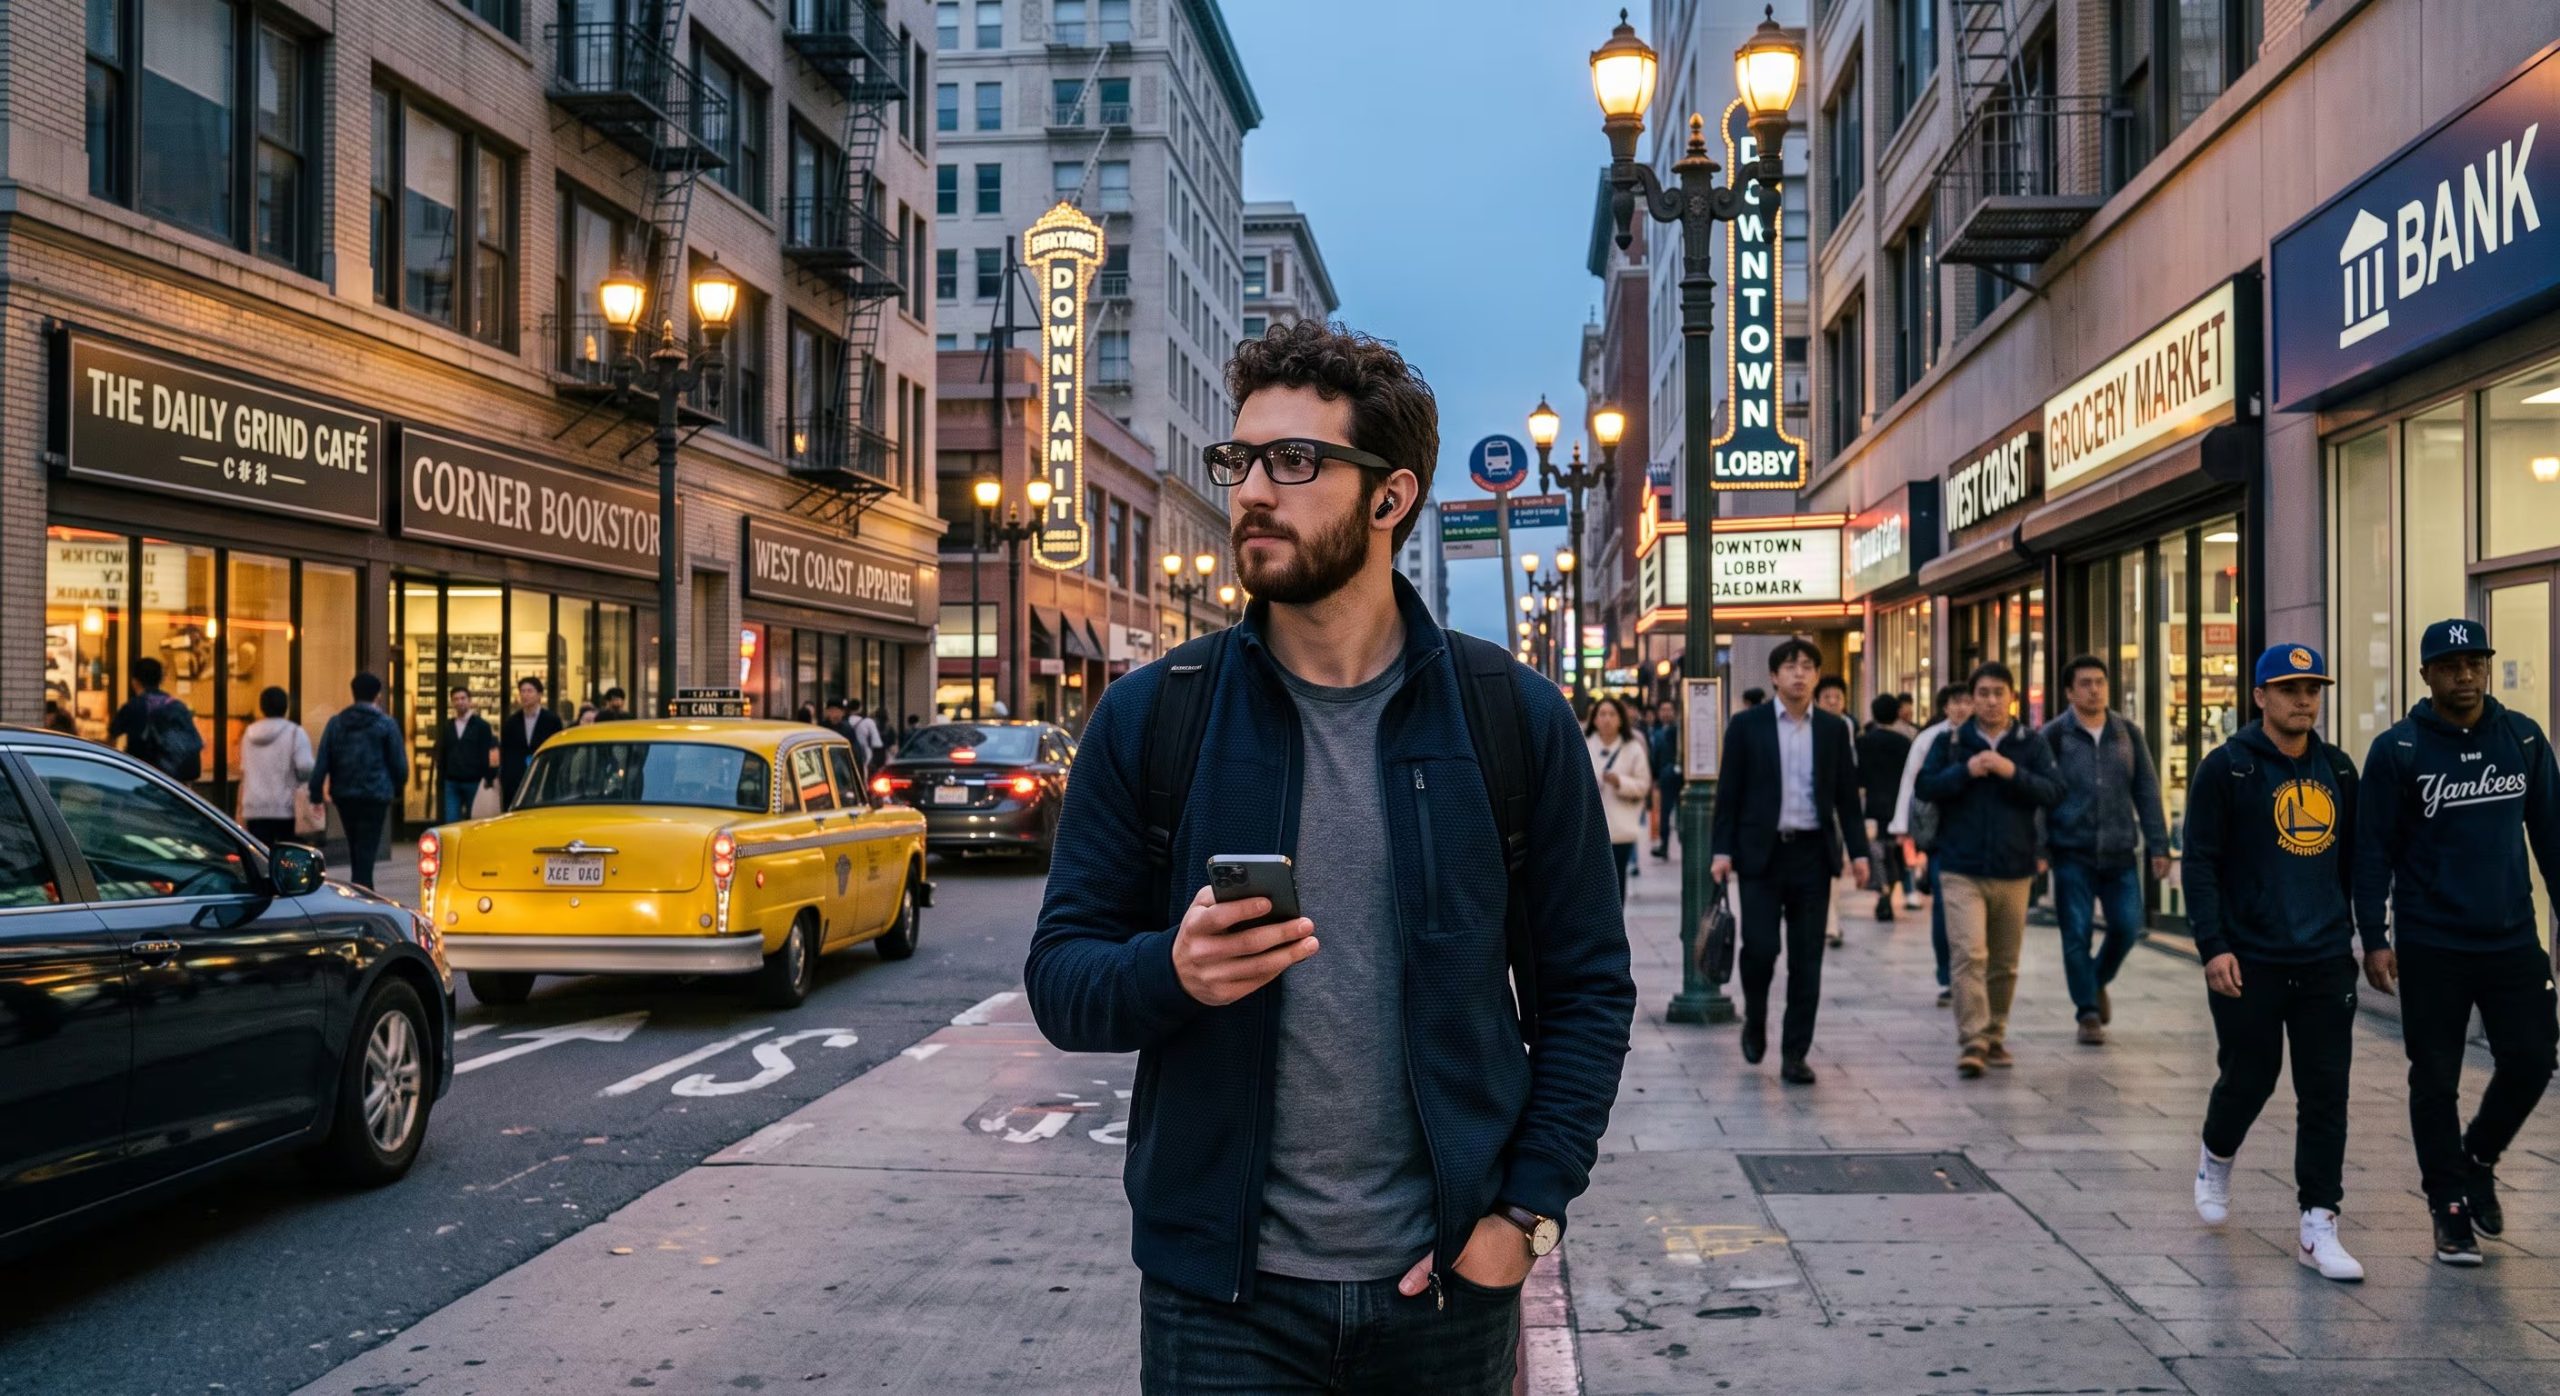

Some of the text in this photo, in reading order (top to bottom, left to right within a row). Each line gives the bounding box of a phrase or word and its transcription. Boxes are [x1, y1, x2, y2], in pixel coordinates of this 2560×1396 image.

[2397, 122, 2541, 300] BANK
[87, 367, 144, 425] THE
[152, 384, 228, 443] DAILY
[234, 404, 308, 460] GRIND
[314, 425, 368, 475] CAFÉ
[1050, 267, 1076, 519] DOWNTAMIT
[2049, 310, 2226, 473] GROCERY MARKET
[413, 456, 660, 557] CORNER BOOKSTOR
[1715, 451, 1796, 476] LOBBY
[1946, 430, 2029, 533] WEST COAST
[755, 538, 913, 607] WEST COAST APPAREL
[1712, 538, 1802, 555] OWNTOWN
[1724, 560, 1777, 576] LOBBY
[2417, 763, 2527, 818] Yankees
